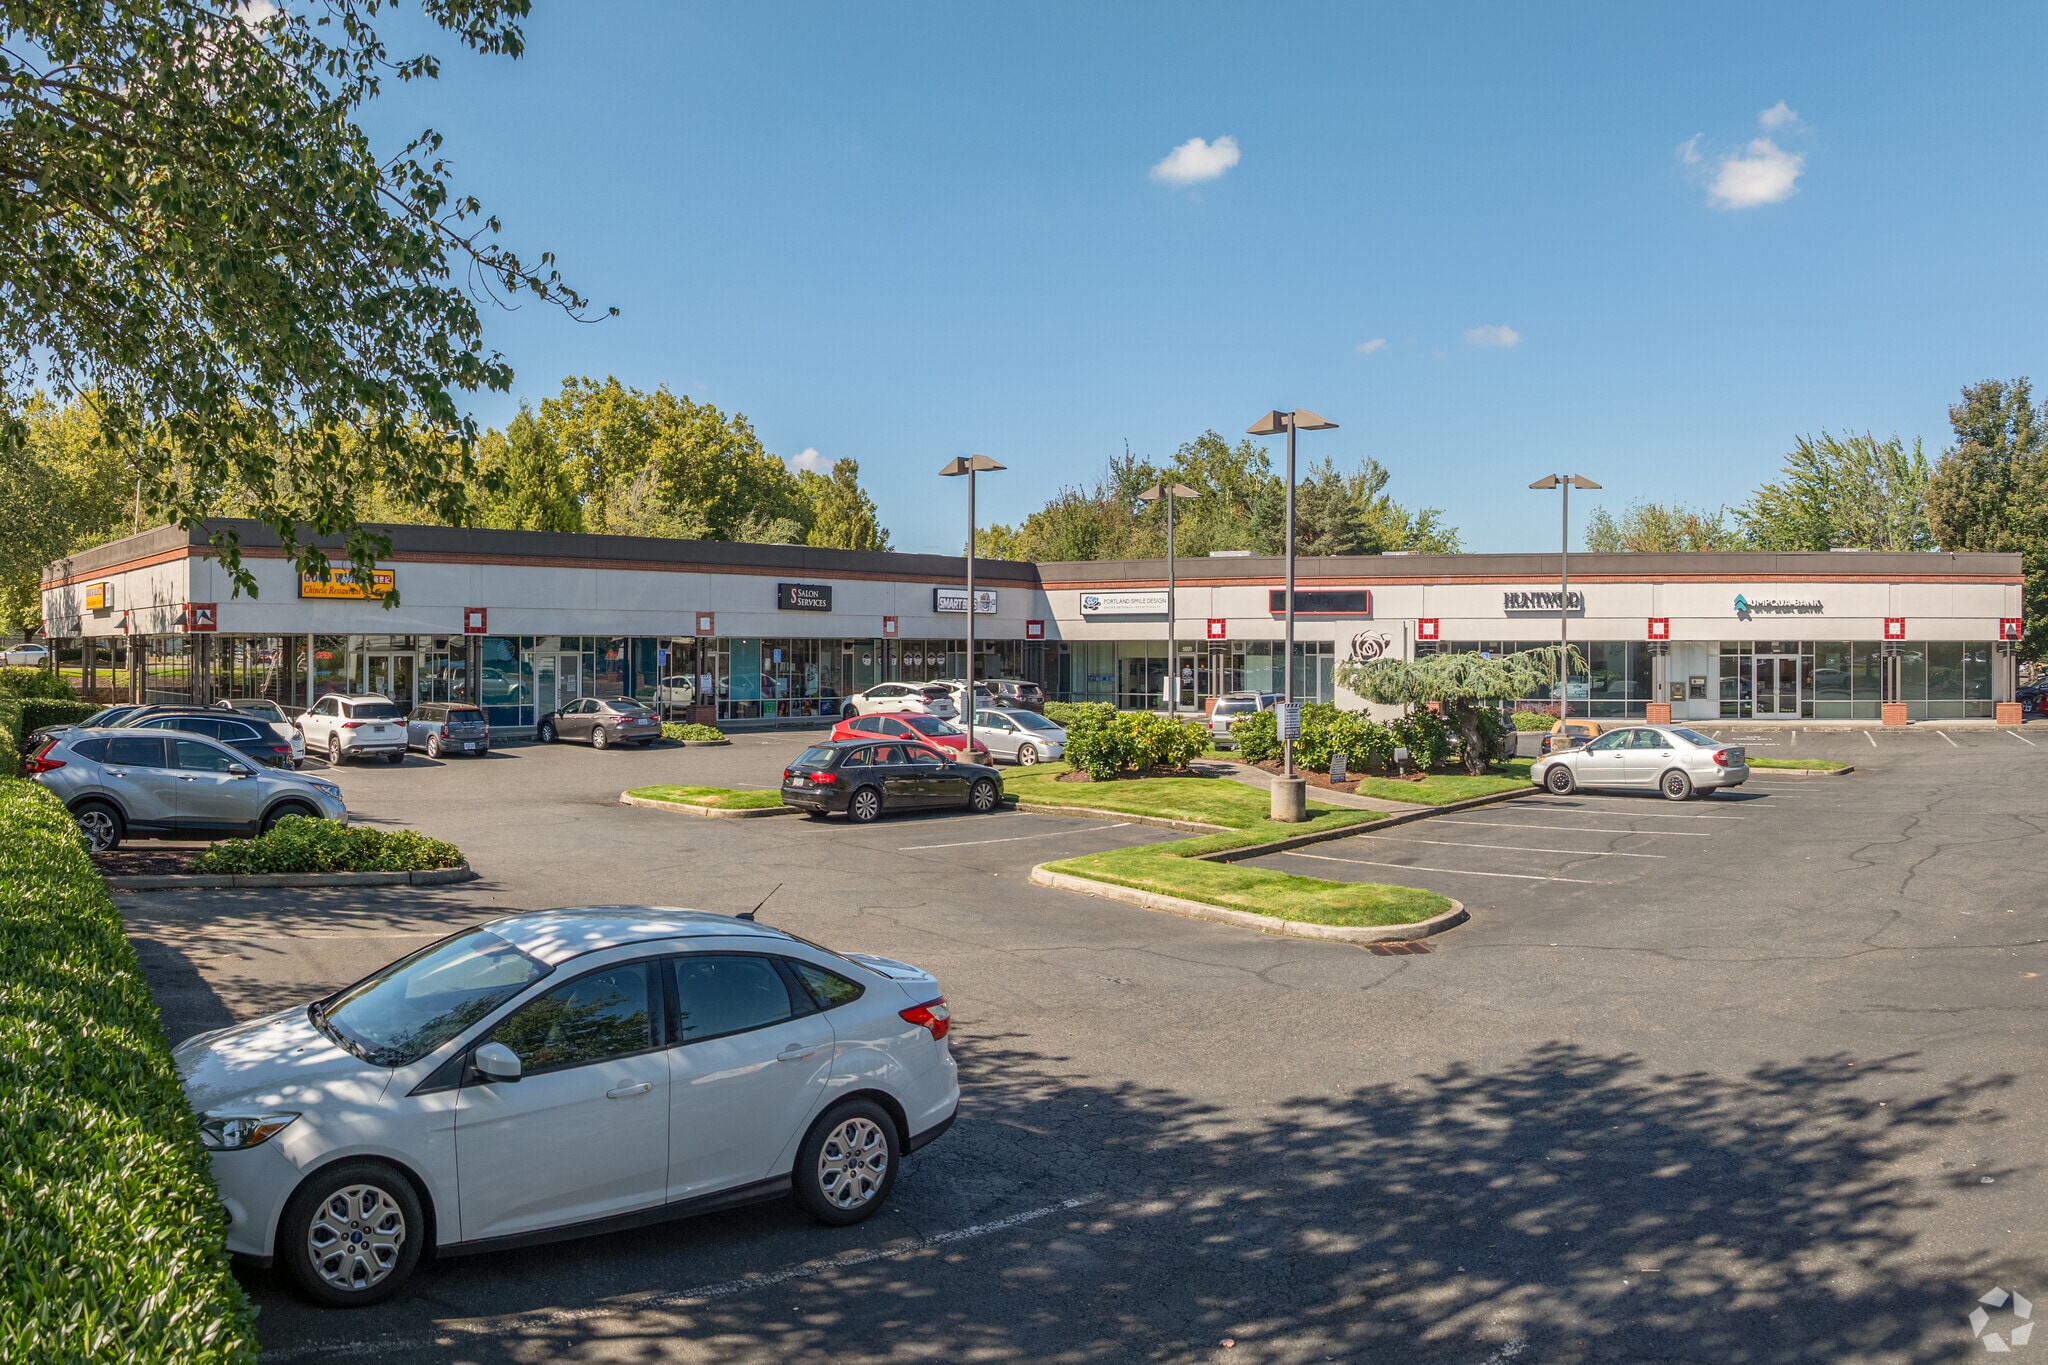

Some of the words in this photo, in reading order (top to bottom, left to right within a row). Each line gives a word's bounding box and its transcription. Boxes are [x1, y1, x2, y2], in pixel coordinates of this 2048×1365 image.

[303, 585, 329, 595] Chinese
[797, 588, 819, 598] SALON
[797, 597, 827, 607] SERVICES
[1130, 597, 1146, 605] SMILE
[1503, 591, 1581, 609] HUNTWOD
[1750, 599, 1791, 607] UMPQUA
[1795, 599, 1821, 607] BANK
[315, 651, 333, 659] OPEN
